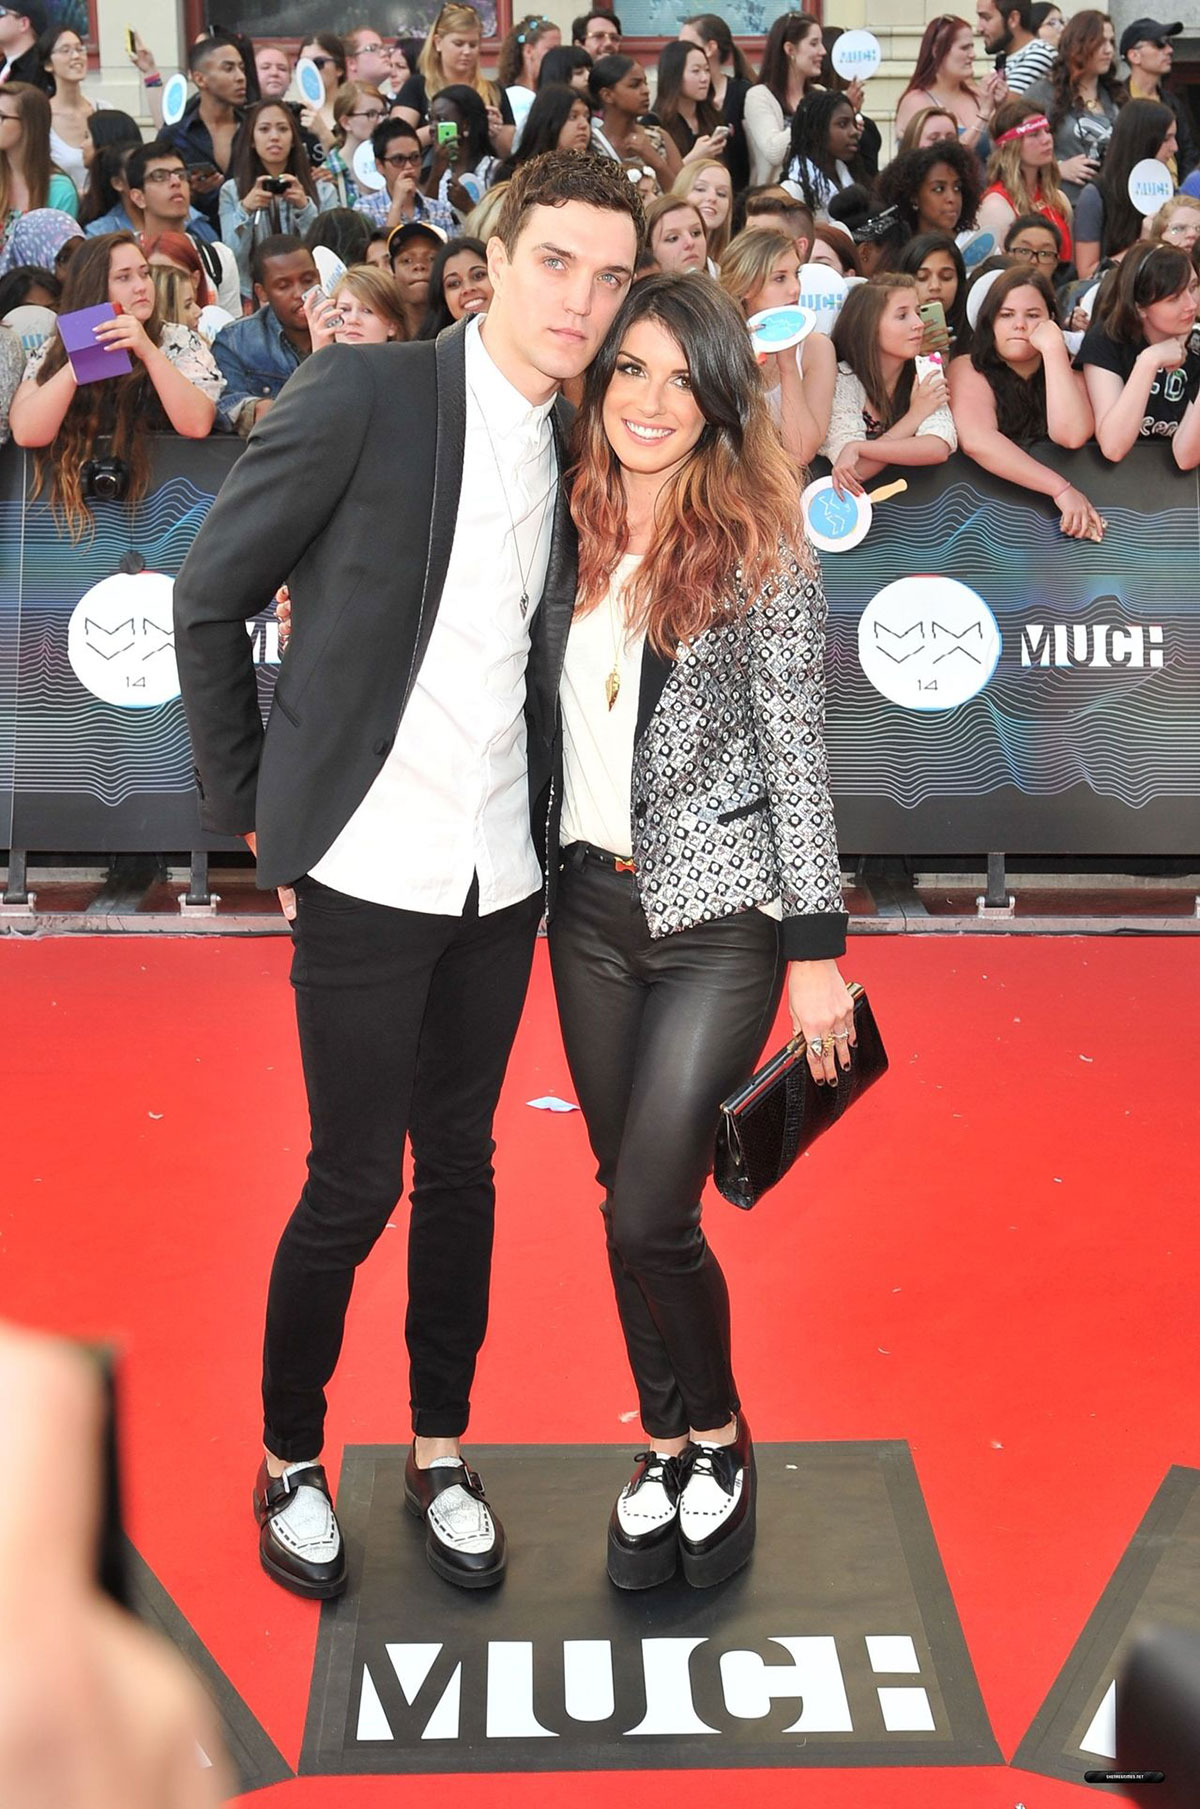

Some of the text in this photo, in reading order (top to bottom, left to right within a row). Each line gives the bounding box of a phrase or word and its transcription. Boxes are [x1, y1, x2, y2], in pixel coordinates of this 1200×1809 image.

[799, 293, 843, 312] UCH
[1021, 624, 1164, 667] MUCH
[125, 676, 146, 688] 14
[917, 679, 938, 691] 14
[356, 1635, 936, 1741] MUCH
